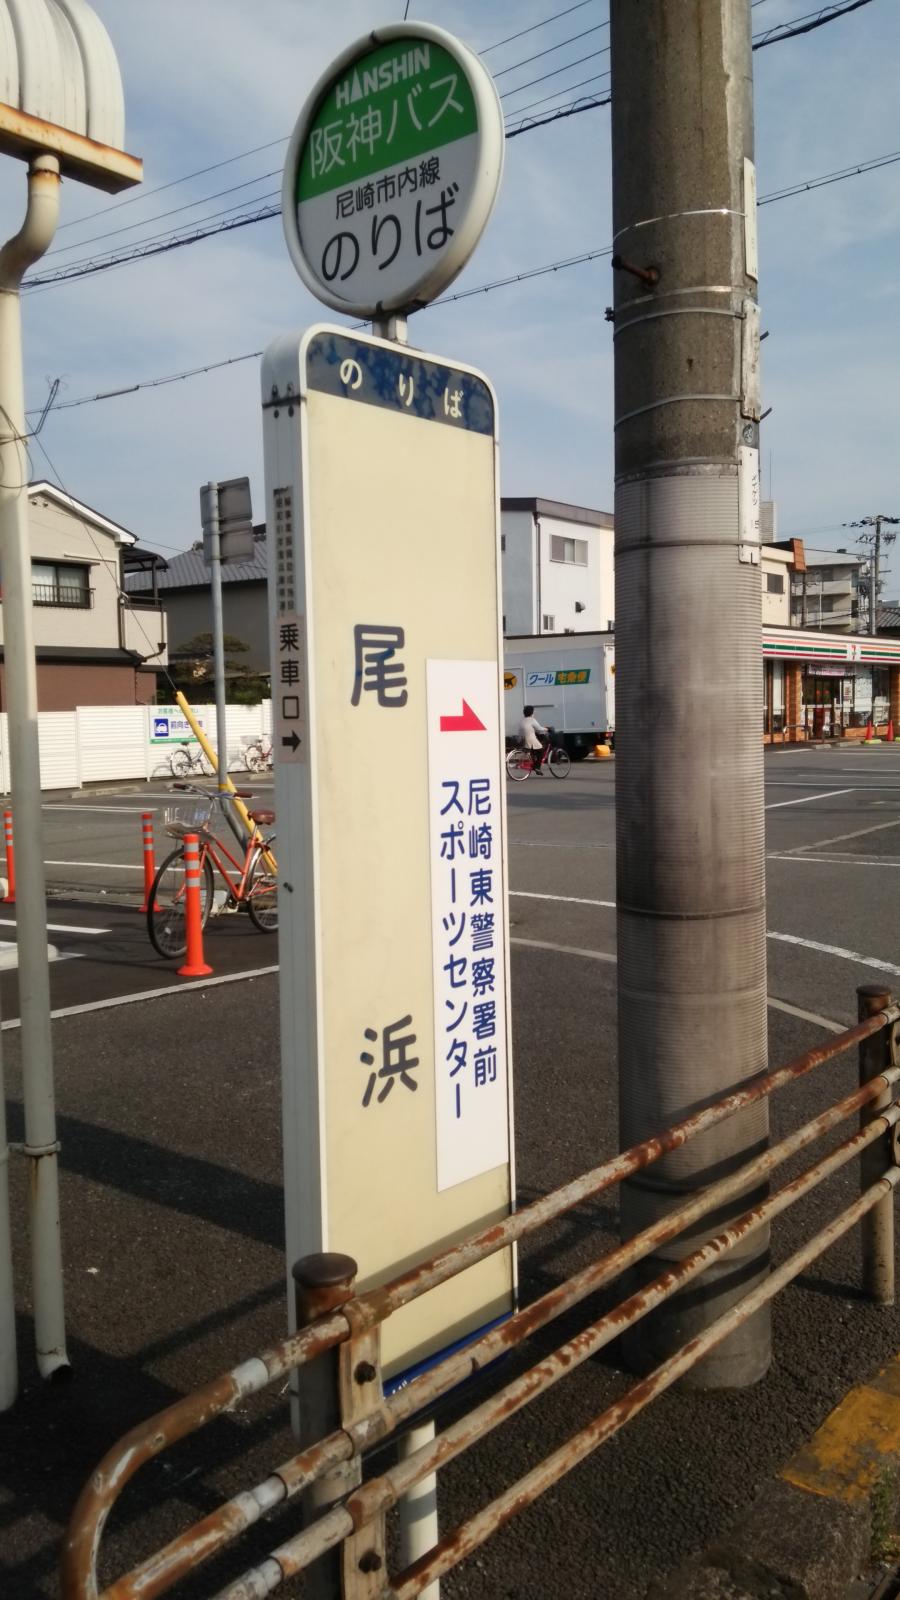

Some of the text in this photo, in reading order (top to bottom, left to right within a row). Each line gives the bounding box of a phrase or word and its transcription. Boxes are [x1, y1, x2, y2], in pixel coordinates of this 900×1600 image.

[309, 73, 464, 180] 阪神バス
[335, 45, 431, 110] HANSHIN
[321, 182, 460, 282] のりば
[335, 155, 441, 221] 尼崎市内線
[340, 358, 464, 418] のりば
[279, 622, 300, 720] 乗車口
[440, 780, 468, 1119] スポーツセンター
[467, 778, 498, 1088] 尼崎東警察署前
